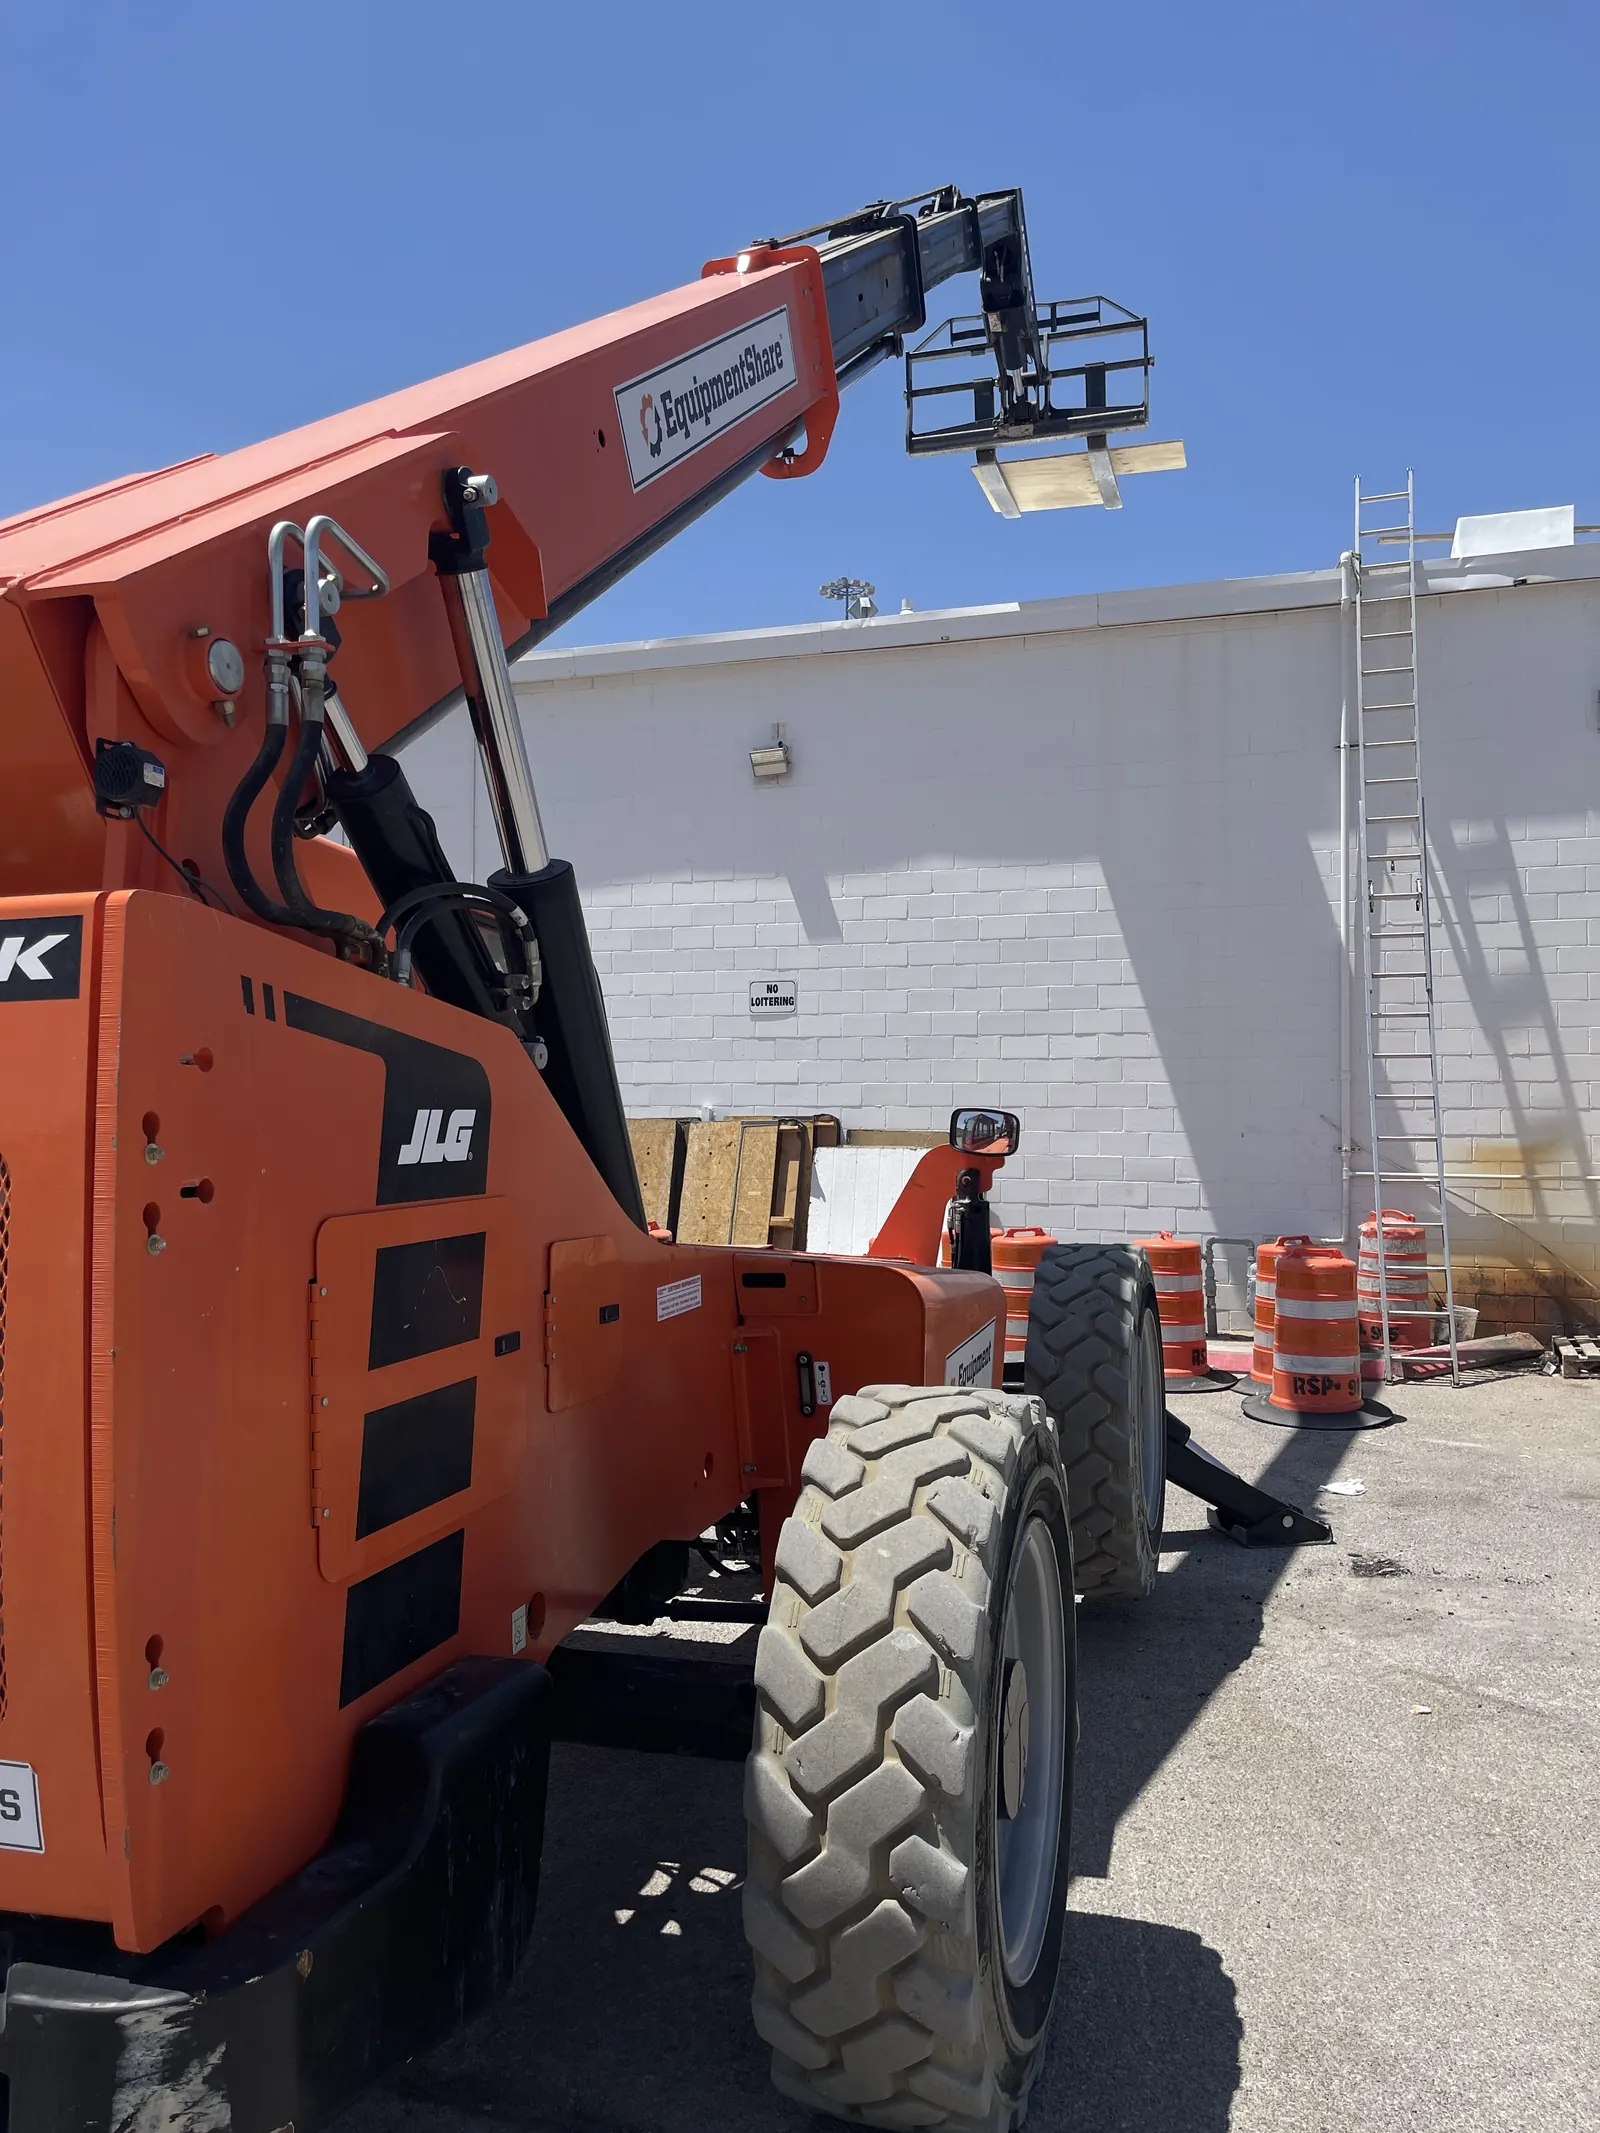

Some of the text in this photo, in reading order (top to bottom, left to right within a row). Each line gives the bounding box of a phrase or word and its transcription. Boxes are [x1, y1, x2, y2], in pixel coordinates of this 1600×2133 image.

[660, 341, 784, 440] EquipmentShare
[751, 996, 794, 1007] LOITERING
[766, 984, 779, 994] NO
[397, 1109, 477, 1165] JLG
[958, 1340, 992, 1386] Equipment
